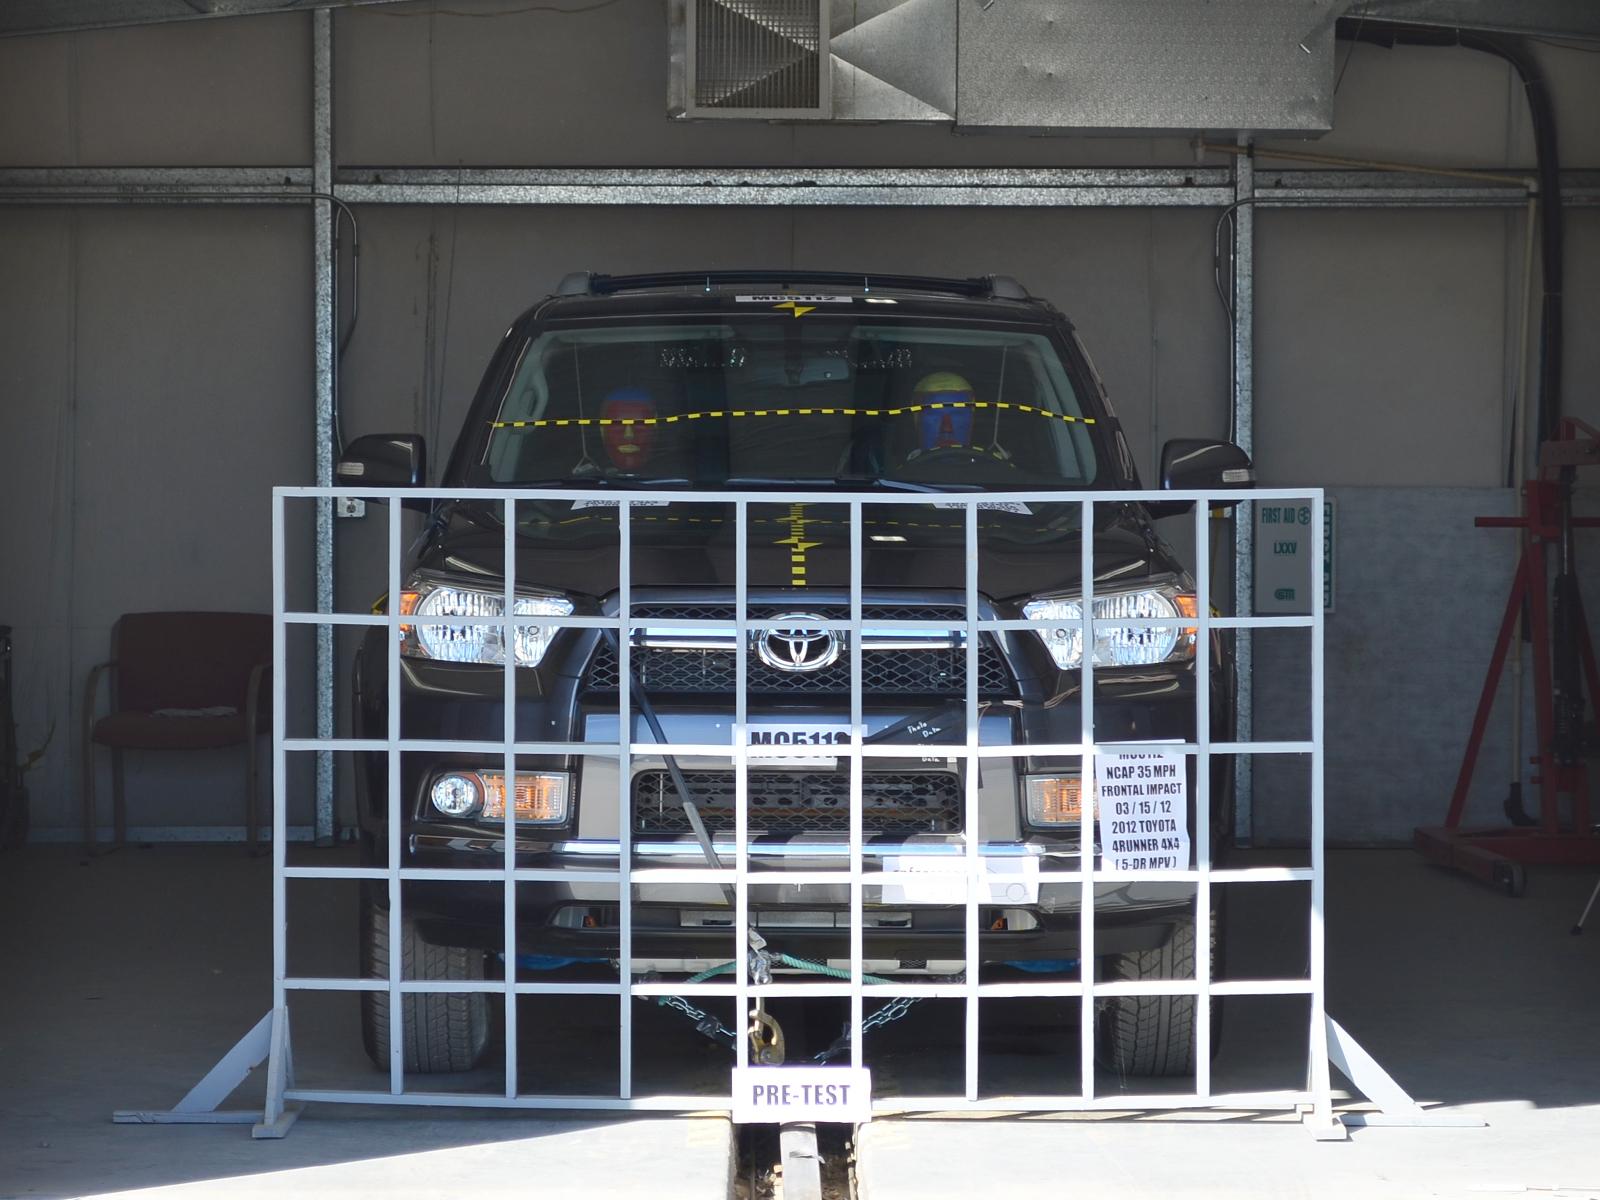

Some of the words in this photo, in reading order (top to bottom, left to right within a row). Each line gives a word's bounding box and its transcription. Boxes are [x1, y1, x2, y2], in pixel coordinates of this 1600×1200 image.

[1262, 507, 1281, 524] FIRST
[1284, 507, 1296, 524] AID
[1273, 542, 1297, 554] LXXV
[1106, 766, 1135, 779] NCAP
[1137, 765, 1152, 778] 35
[1153, 764, 1176, 778] MPH
[1102, 784, 1144, 797] FRONTAL
[1146, 783, 1182, 796] IMPACT
[1111, 820, 1137, 834] 2012
[1138, 819, 1177, 833] TOYOTA
[1112, 838, 1159, 852] 4RUNNER
[1161, 837, 1180, 850] 4X4
[752, 1084, 851, 1106] PRE-TEST
